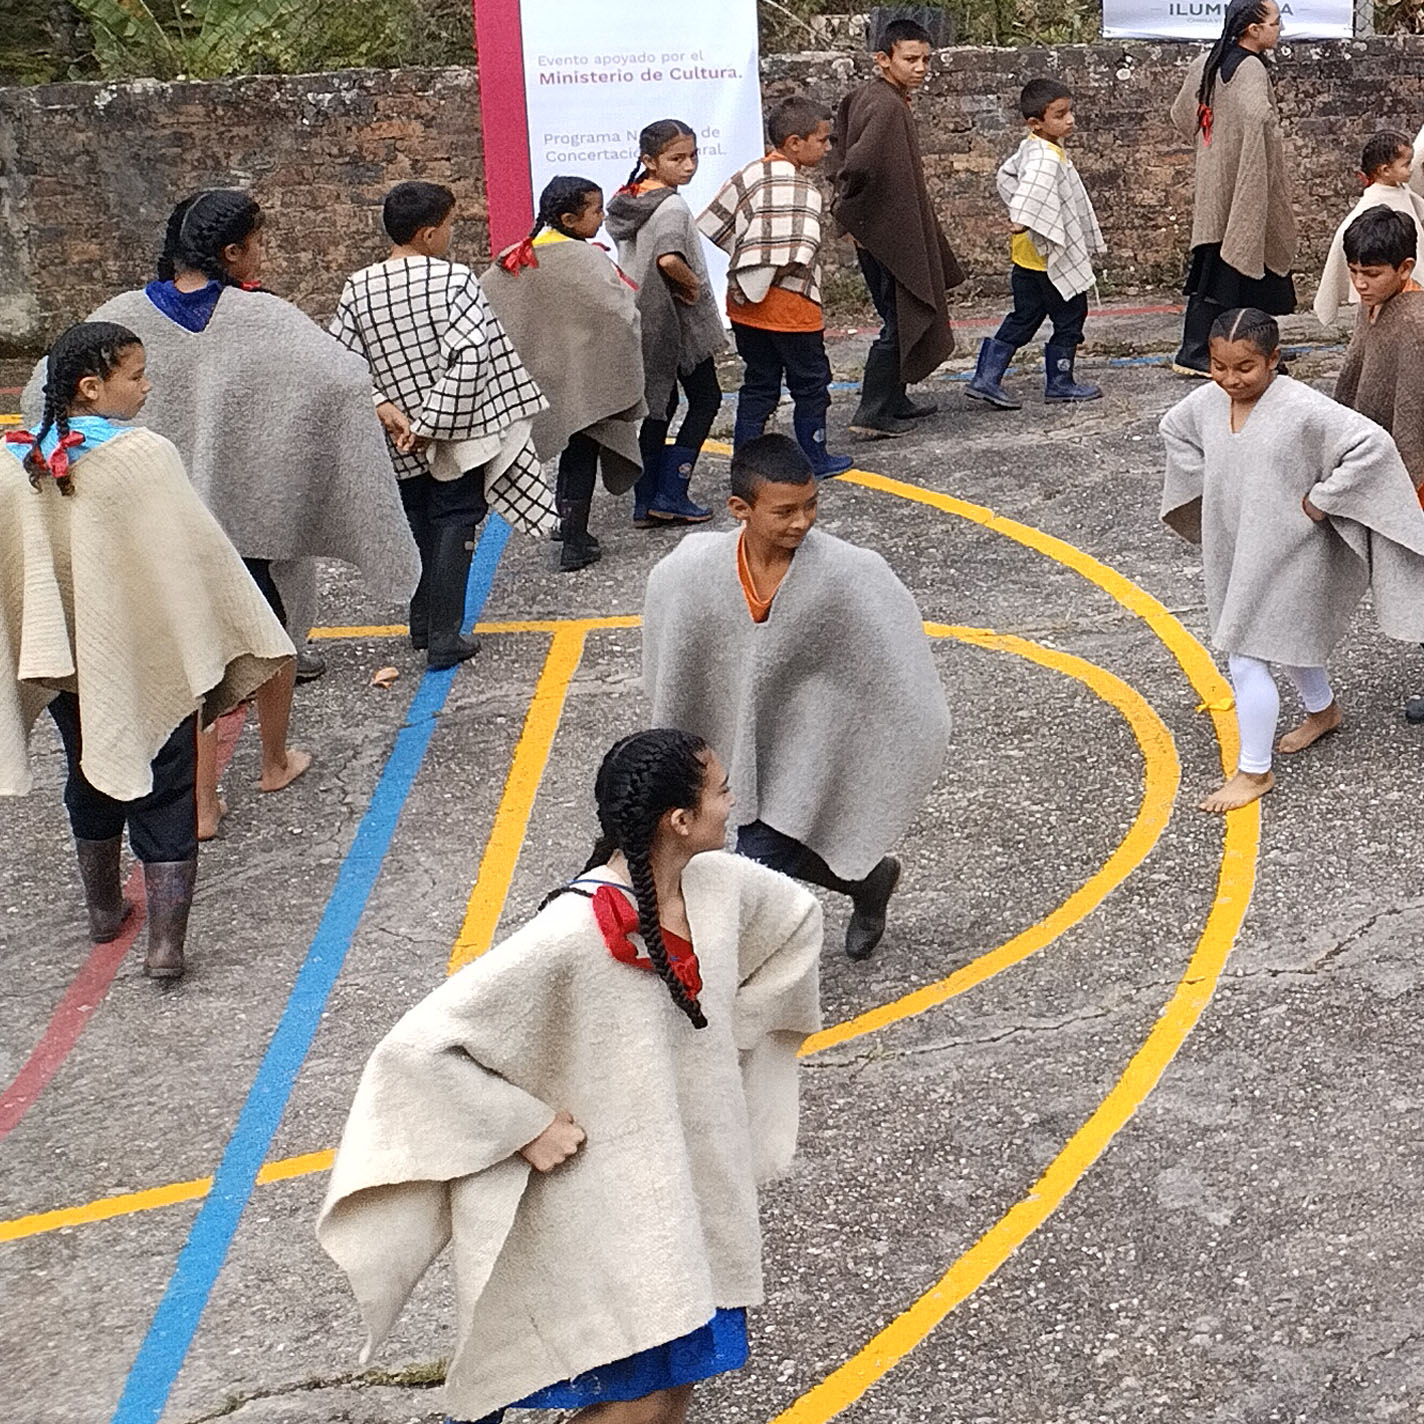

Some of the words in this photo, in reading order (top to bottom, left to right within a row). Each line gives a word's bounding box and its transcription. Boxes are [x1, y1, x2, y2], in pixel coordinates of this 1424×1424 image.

[1169, 3, 1294, 16] ILUMA
[538, 55, 589, 67] Evento
[594, 52, 656, 67] apoyado
[661, 53, 685, 64] por
[690, 50, 704, 62] el
[539, 70, 634, 85] Ministerio
[640, 68, 663, 82] de
[669, 65, 743, 81] Cultura.
[544, 133, 621, 147] Programa
[702, 126, 720, 138] de
